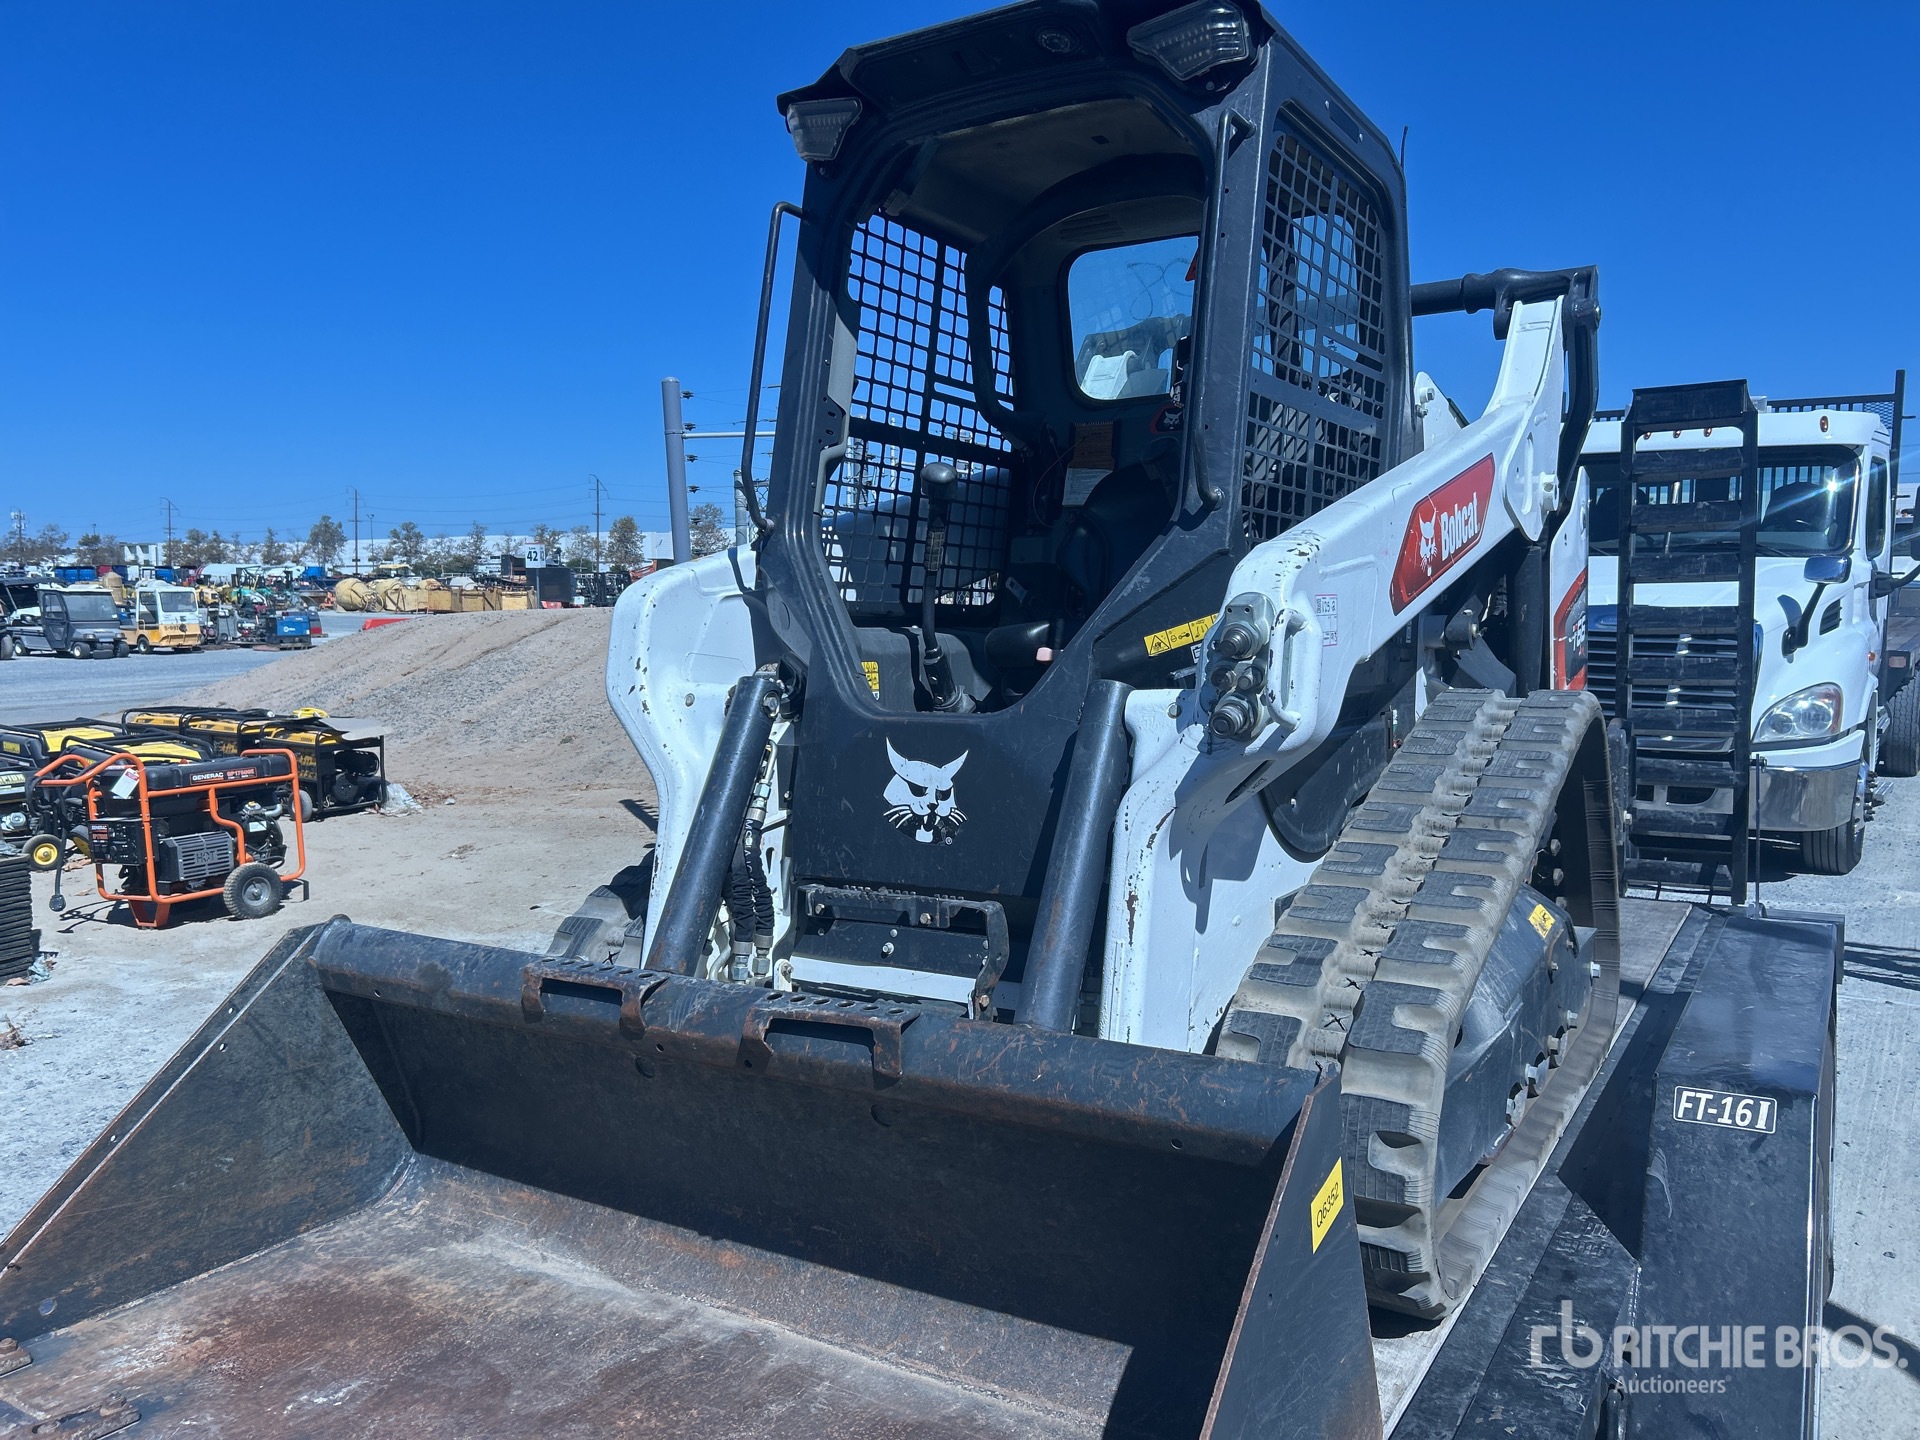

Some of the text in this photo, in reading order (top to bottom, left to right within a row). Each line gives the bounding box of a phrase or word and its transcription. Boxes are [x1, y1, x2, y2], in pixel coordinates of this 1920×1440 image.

[1441, 491, 1478, 561] Bobcat
[527, 551, 538, 561] 42
[192, 772, 224, 780] GENERAC
[196, 851, 216, 863] HOT
[1316, 1182, 1339, 1228] Q6352
